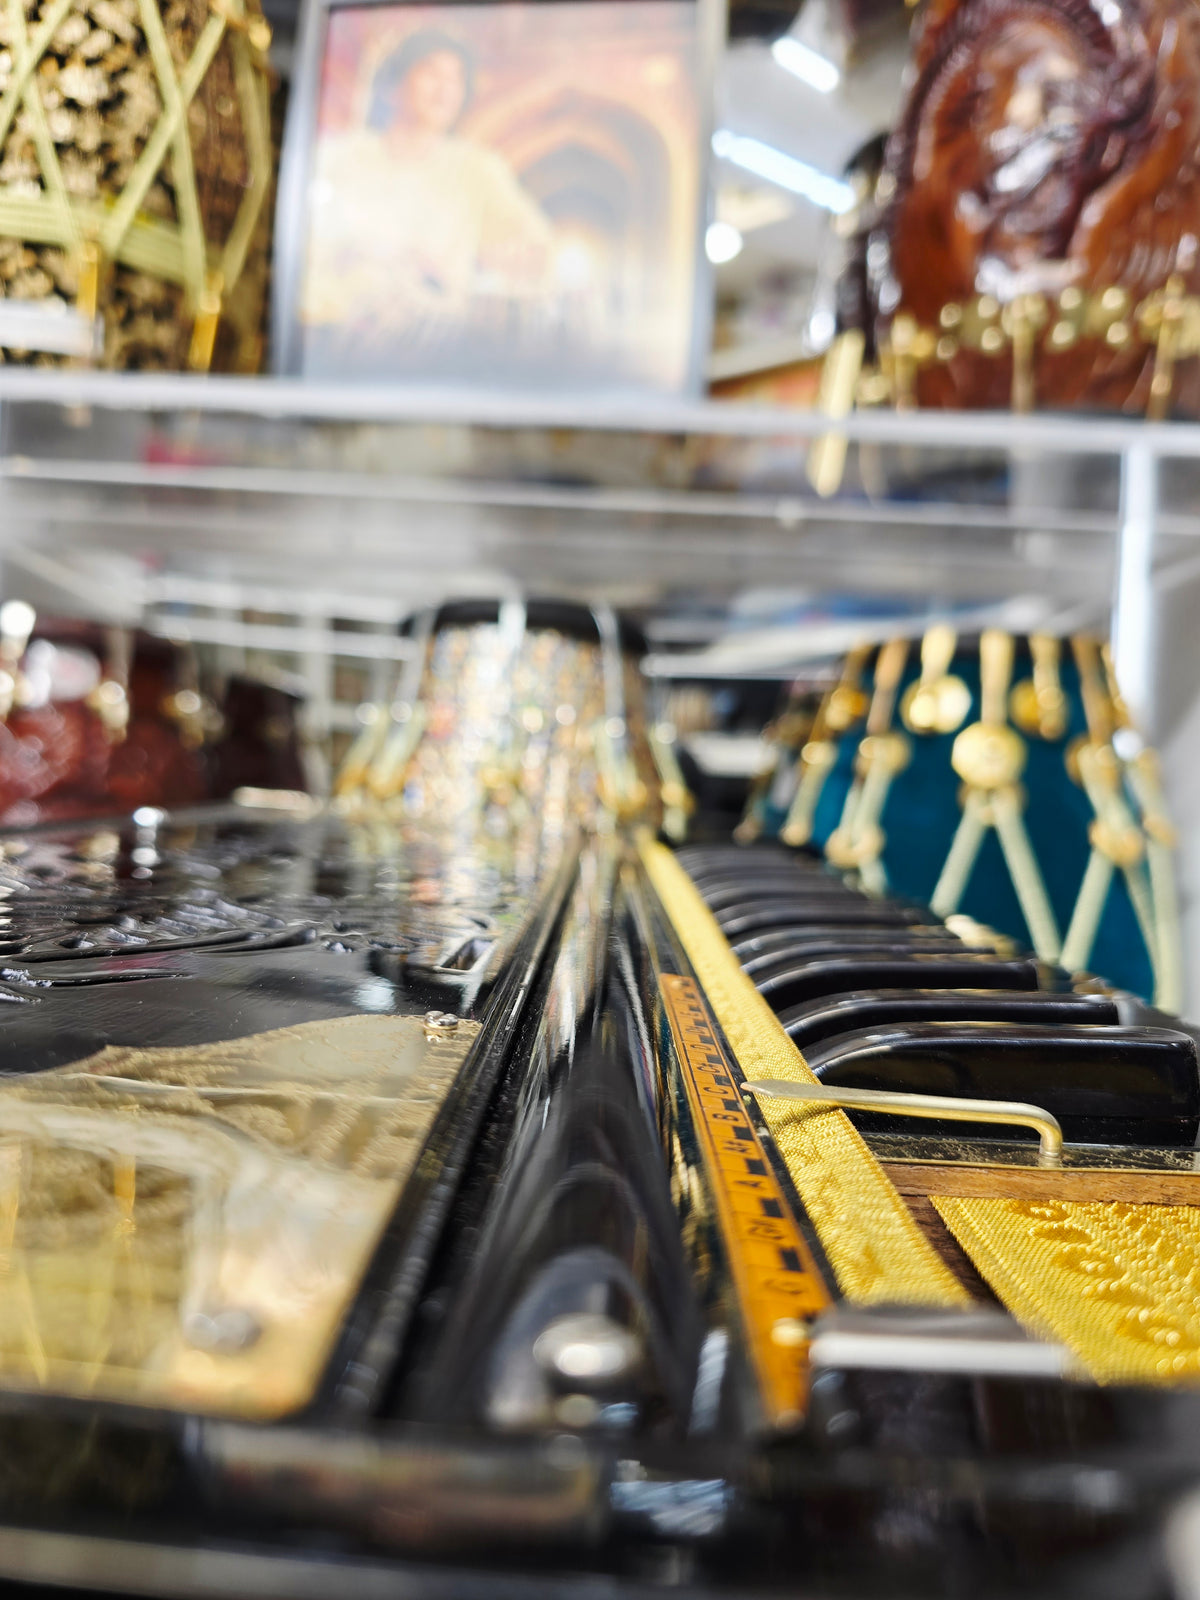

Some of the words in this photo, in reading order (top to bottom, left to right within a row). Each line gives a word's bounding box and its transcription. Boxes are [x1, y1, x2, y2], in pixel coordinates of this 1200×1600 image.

[697, 1062, 721, 1074] C#
[703, 1086, 728, 1094] C
[712, 1112, 739, 1122] B
